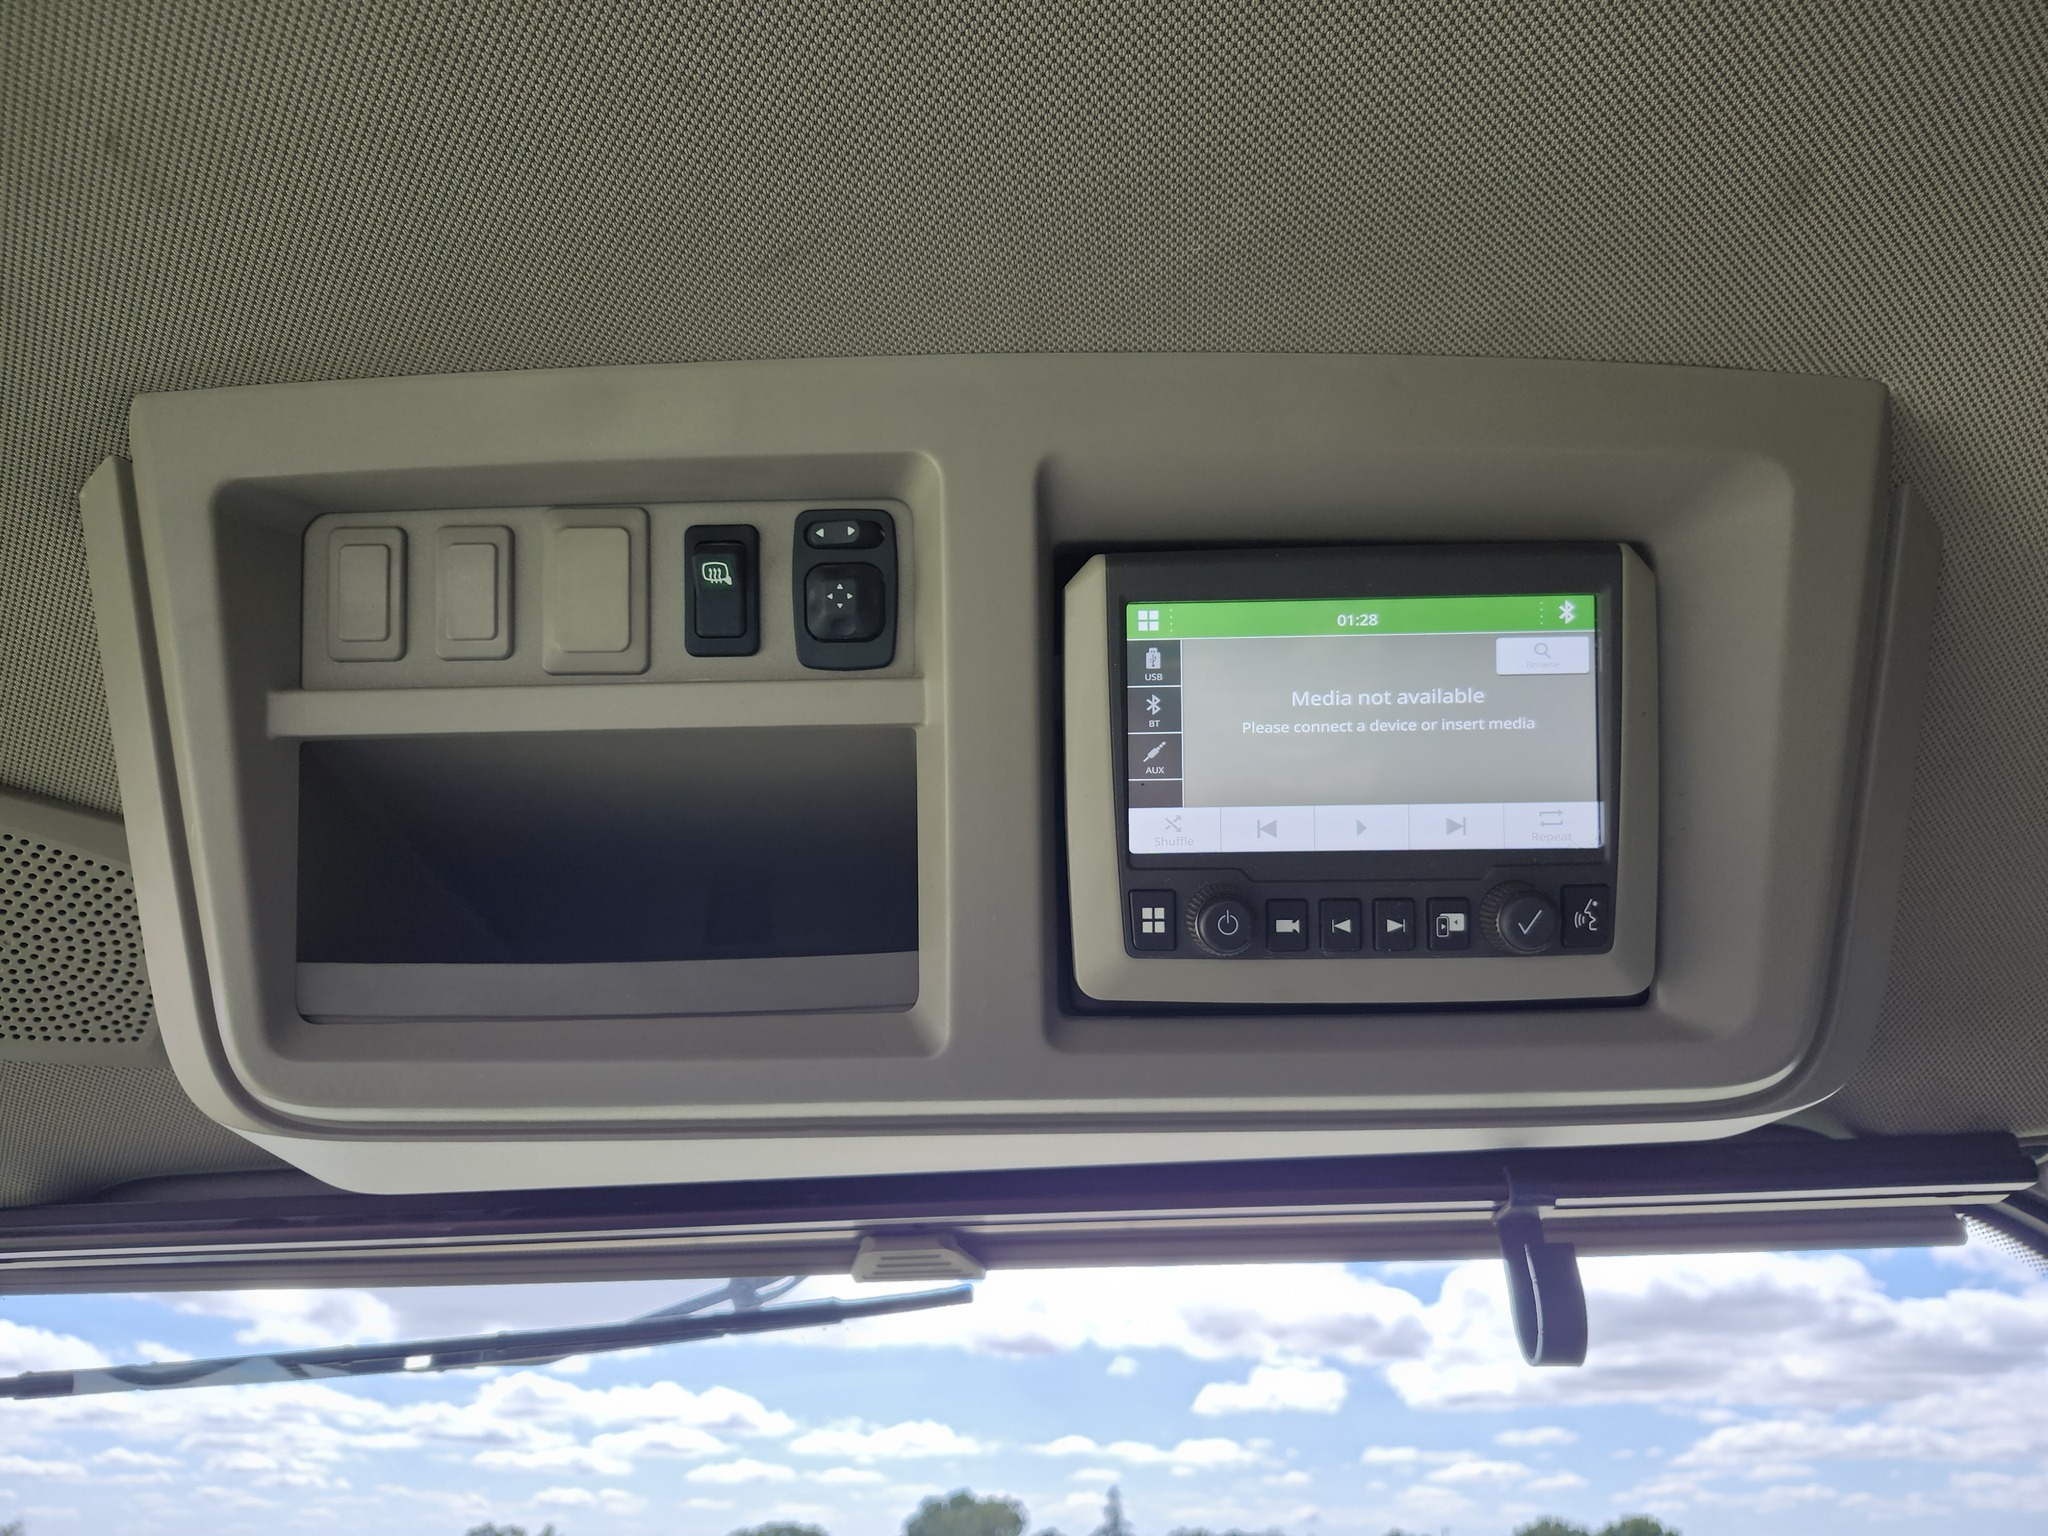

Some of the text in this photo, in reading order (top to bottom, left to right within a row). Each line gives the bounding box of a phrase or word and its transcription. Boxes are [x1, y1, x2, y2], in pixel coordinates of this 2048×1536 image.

[1337, 613, 1379, 627] 01:28
[1144, 673, 1164, 682] USB
[1292, 688, 1485, 706] Media not available
[1148, 719, 1161, 728] BT
[1242, 717, 1536, 734] Please connect a device or insert media
[1145, 766, 1165, 775] AUX
[1154, 836, 1194, 847] Shuffle
[1531, 832, 1573, 844] Repeat
